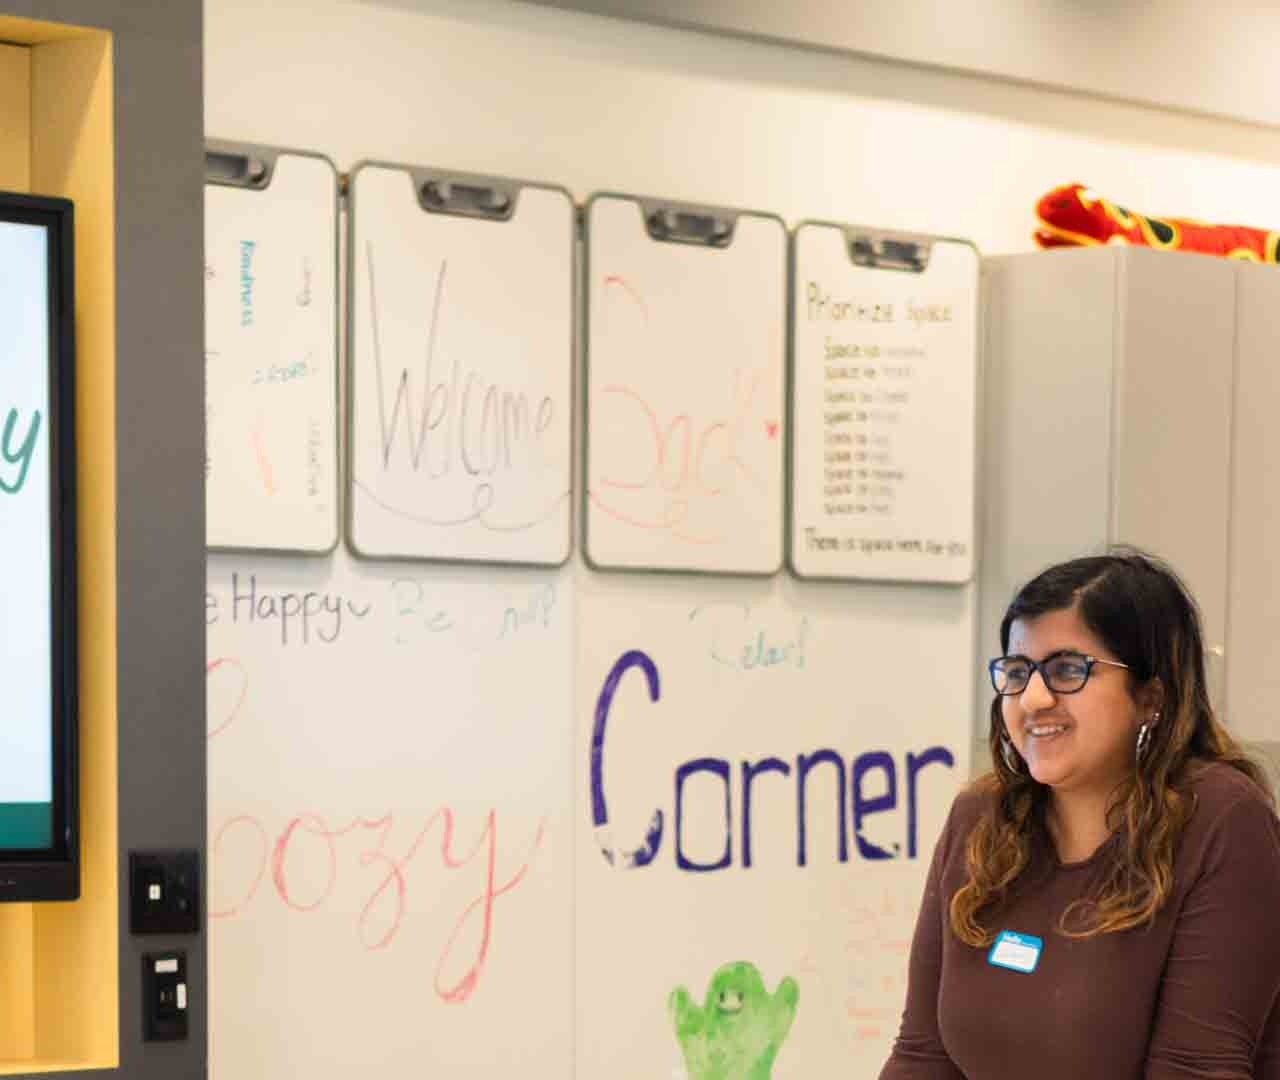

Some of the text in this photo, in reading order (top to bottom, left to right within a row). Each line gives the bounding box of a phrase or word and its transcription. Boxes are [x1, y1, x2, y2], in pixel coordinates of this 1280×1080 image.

[365, 238, 555, 480] Welcome
[232, 572, 342, 646] Happy
[591, 649, 955, 874] Corner
